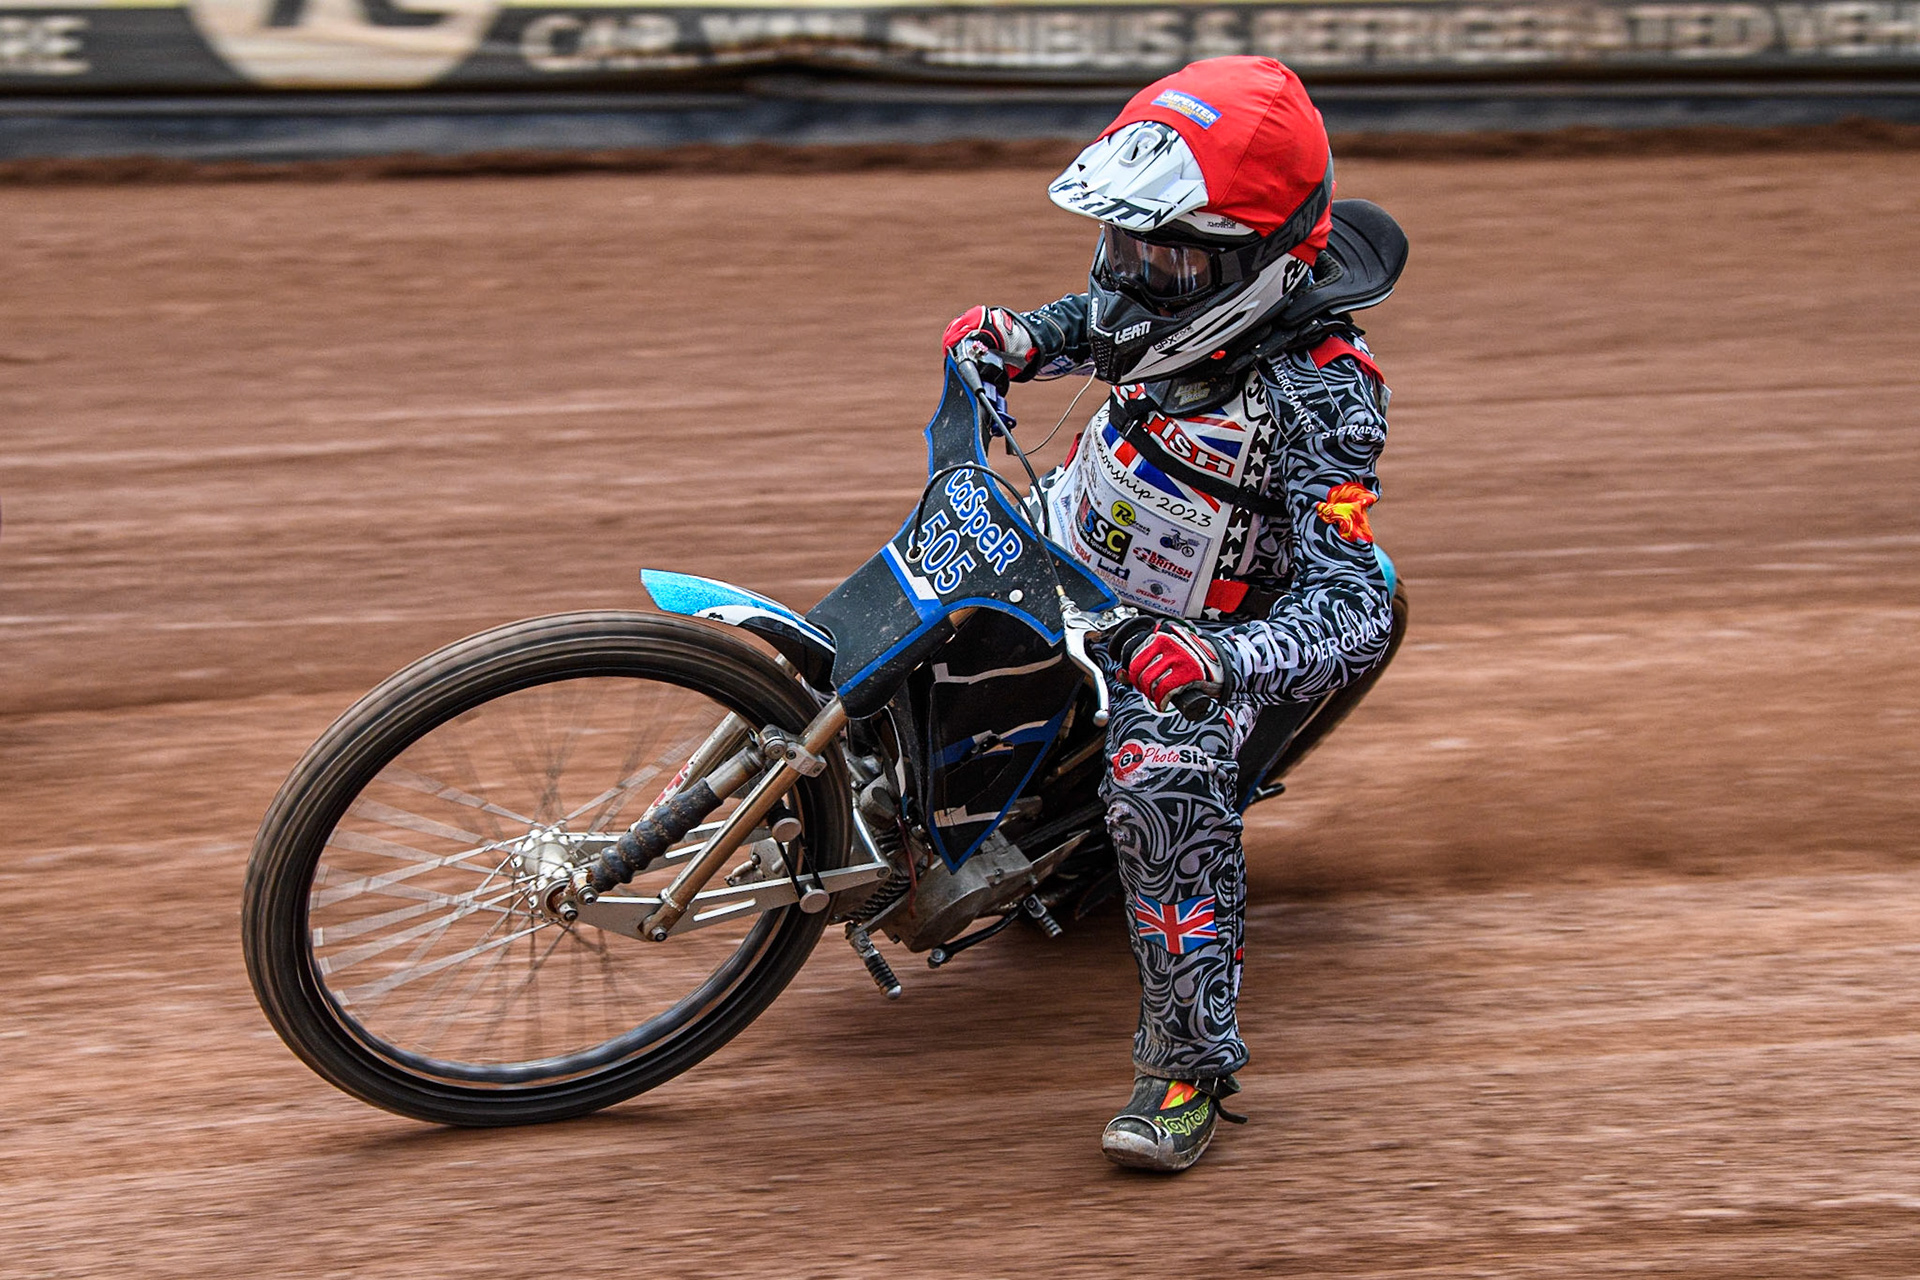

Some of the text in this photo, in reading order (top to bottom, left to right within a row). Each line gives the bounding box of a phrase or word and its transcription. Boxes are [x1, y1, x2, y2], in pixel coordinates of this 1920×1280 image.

[519, 14, 698, 70] CAR
[887, 12, 1181, 67] MINIBUS
[1271, 363, 1315, 434] MERCHANTS
[1156, 497, 1212, 528] 2023
[909, 509, 977, 595] 505
[1148, 552, 1194, 579] BRITISH
